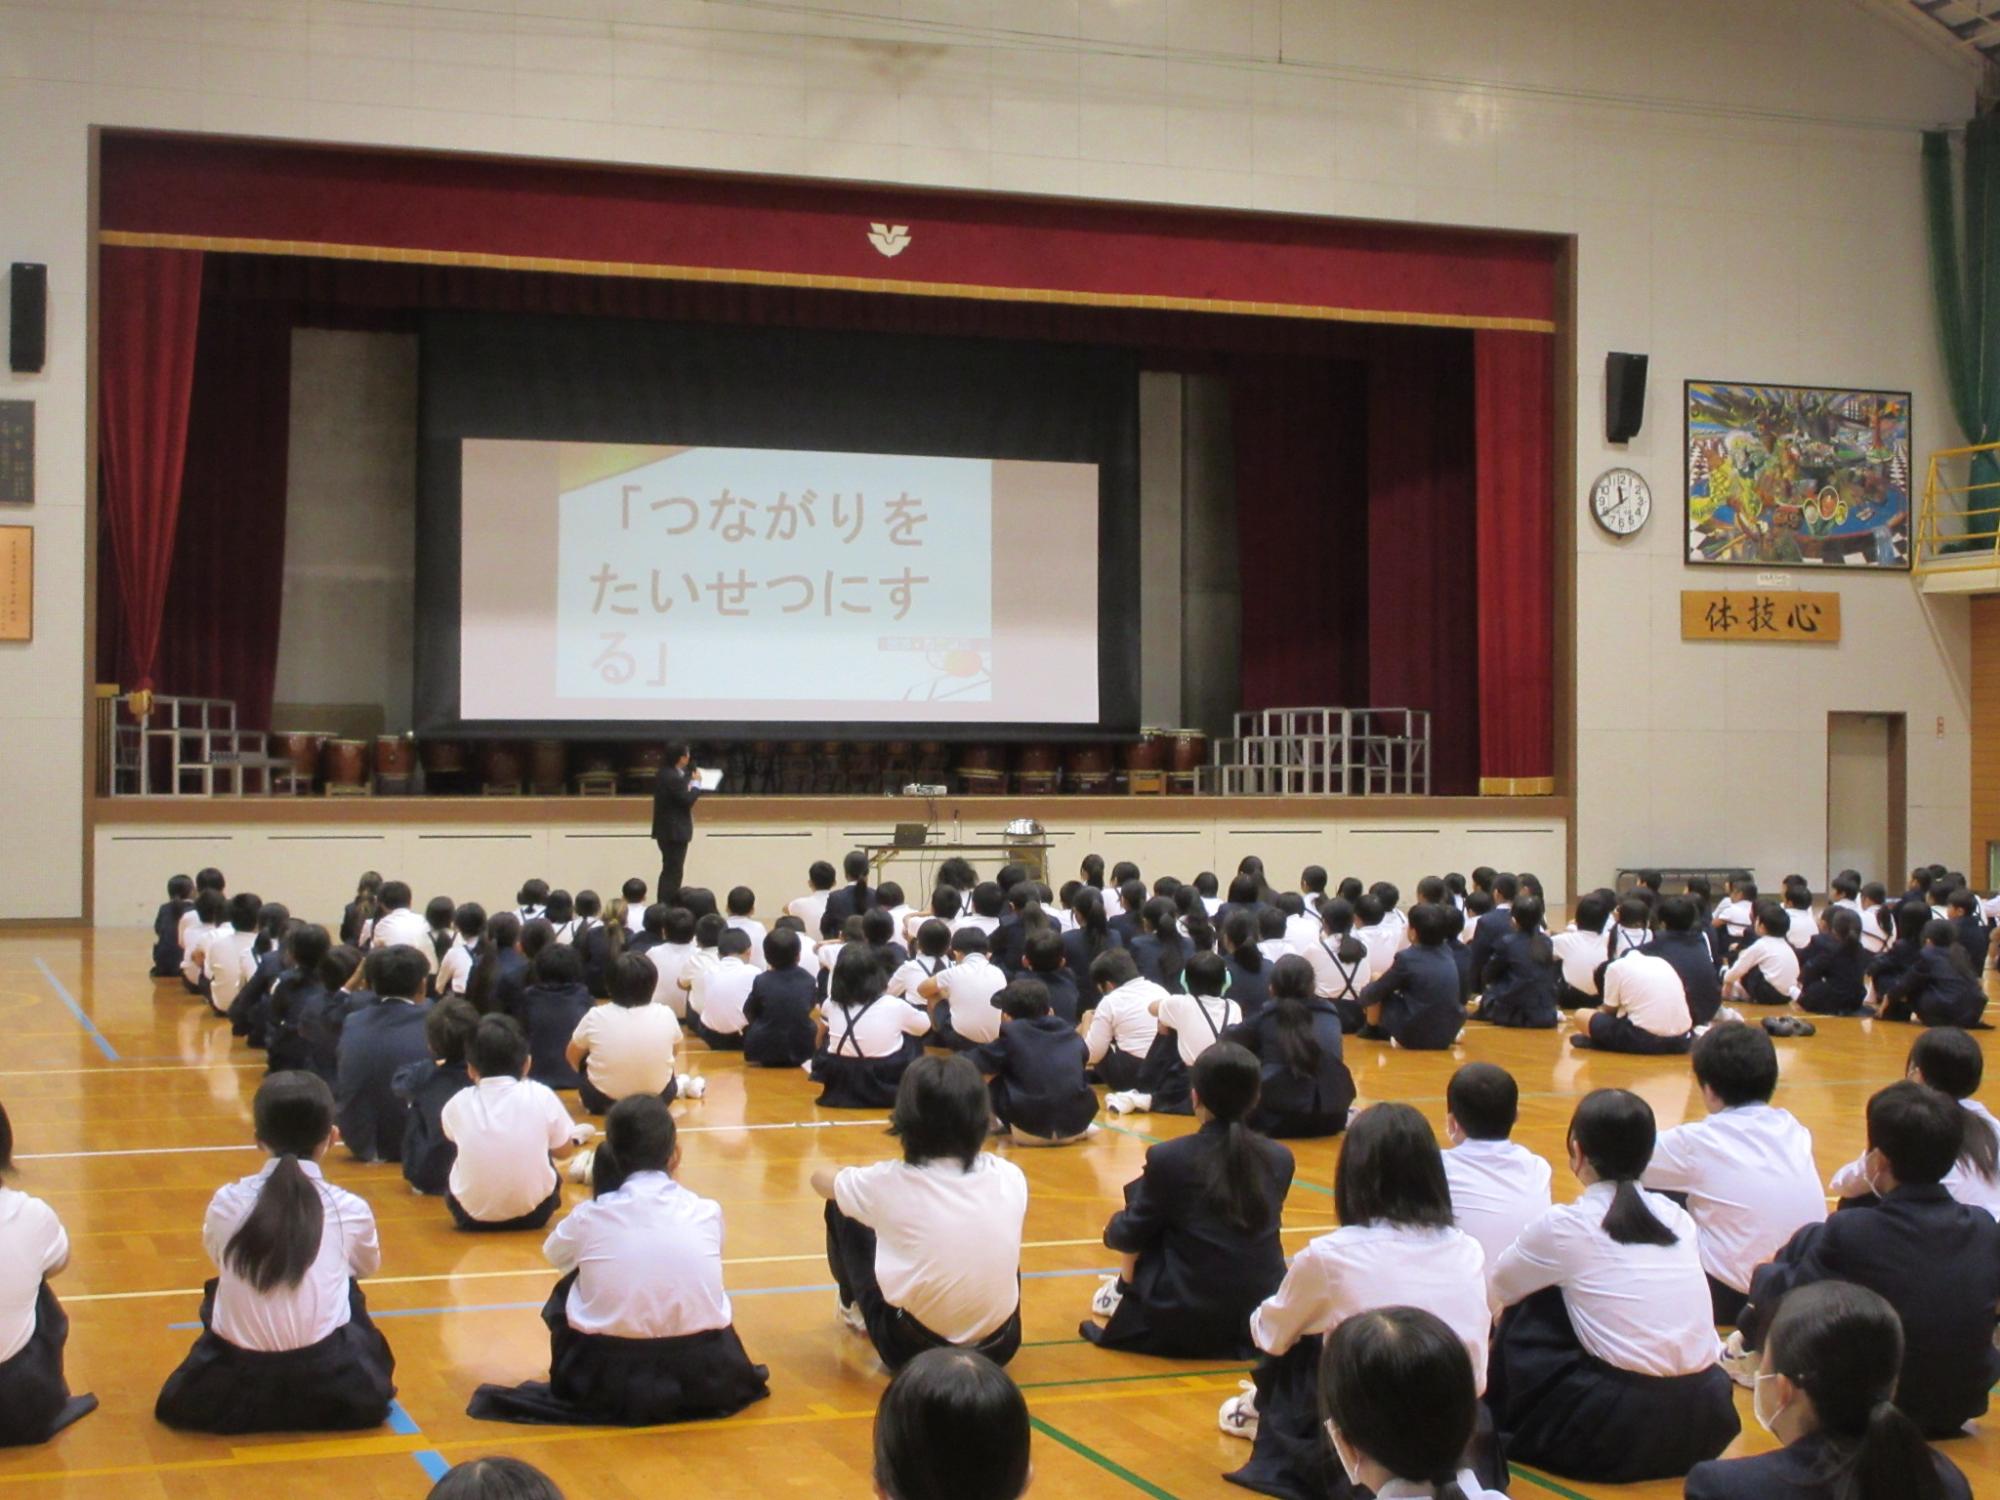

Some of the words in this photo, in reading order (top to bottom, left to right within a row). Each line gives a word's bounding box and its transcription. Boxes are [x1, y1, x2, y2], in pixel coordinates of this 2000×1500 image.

[620, 484, 930, 547] 「つながりを
[589, 562, 930, 621] たいせつにす
[590, 631, 668, 687] る」
